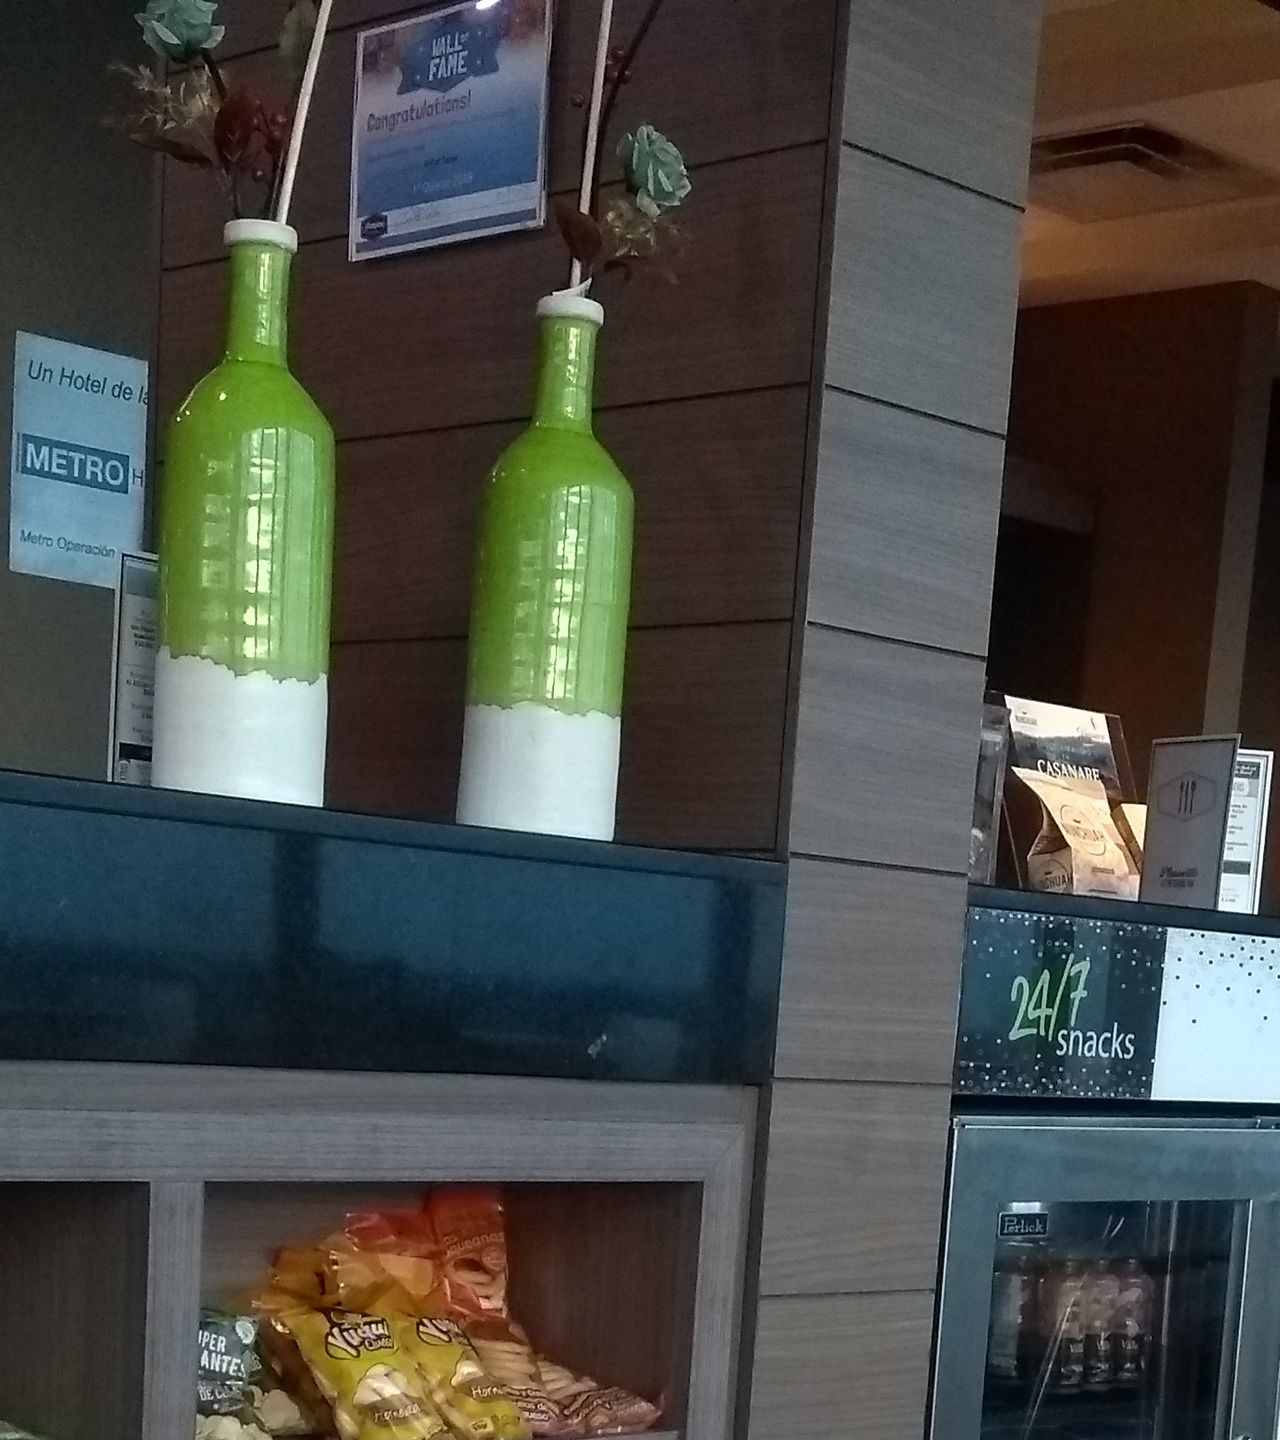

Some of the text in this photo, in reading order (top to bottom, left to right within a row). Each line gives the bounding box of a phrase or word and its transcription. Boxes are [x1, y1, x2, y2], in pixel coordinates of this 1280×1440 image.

[428, 50, 469, 82] FAME
[366, 89, 473, 133] Congratulations!
[27, 359, 54, 384] Un
[58, 366, 108, 395] Hotel
[110, 378, 135, 402] de
[25, 442, 125, 487] METRO
[19, 528, 116, 559] Metro Operación
[1037, 758, 1100, 781] CASANARE
[1007, 952, 1091, 1042] 24/7
[1055, 1021, 1136, 1060] snacks
[1003, 1215, 1044, 1234] Perlick
[198, 1329, 227, 1353] PER
